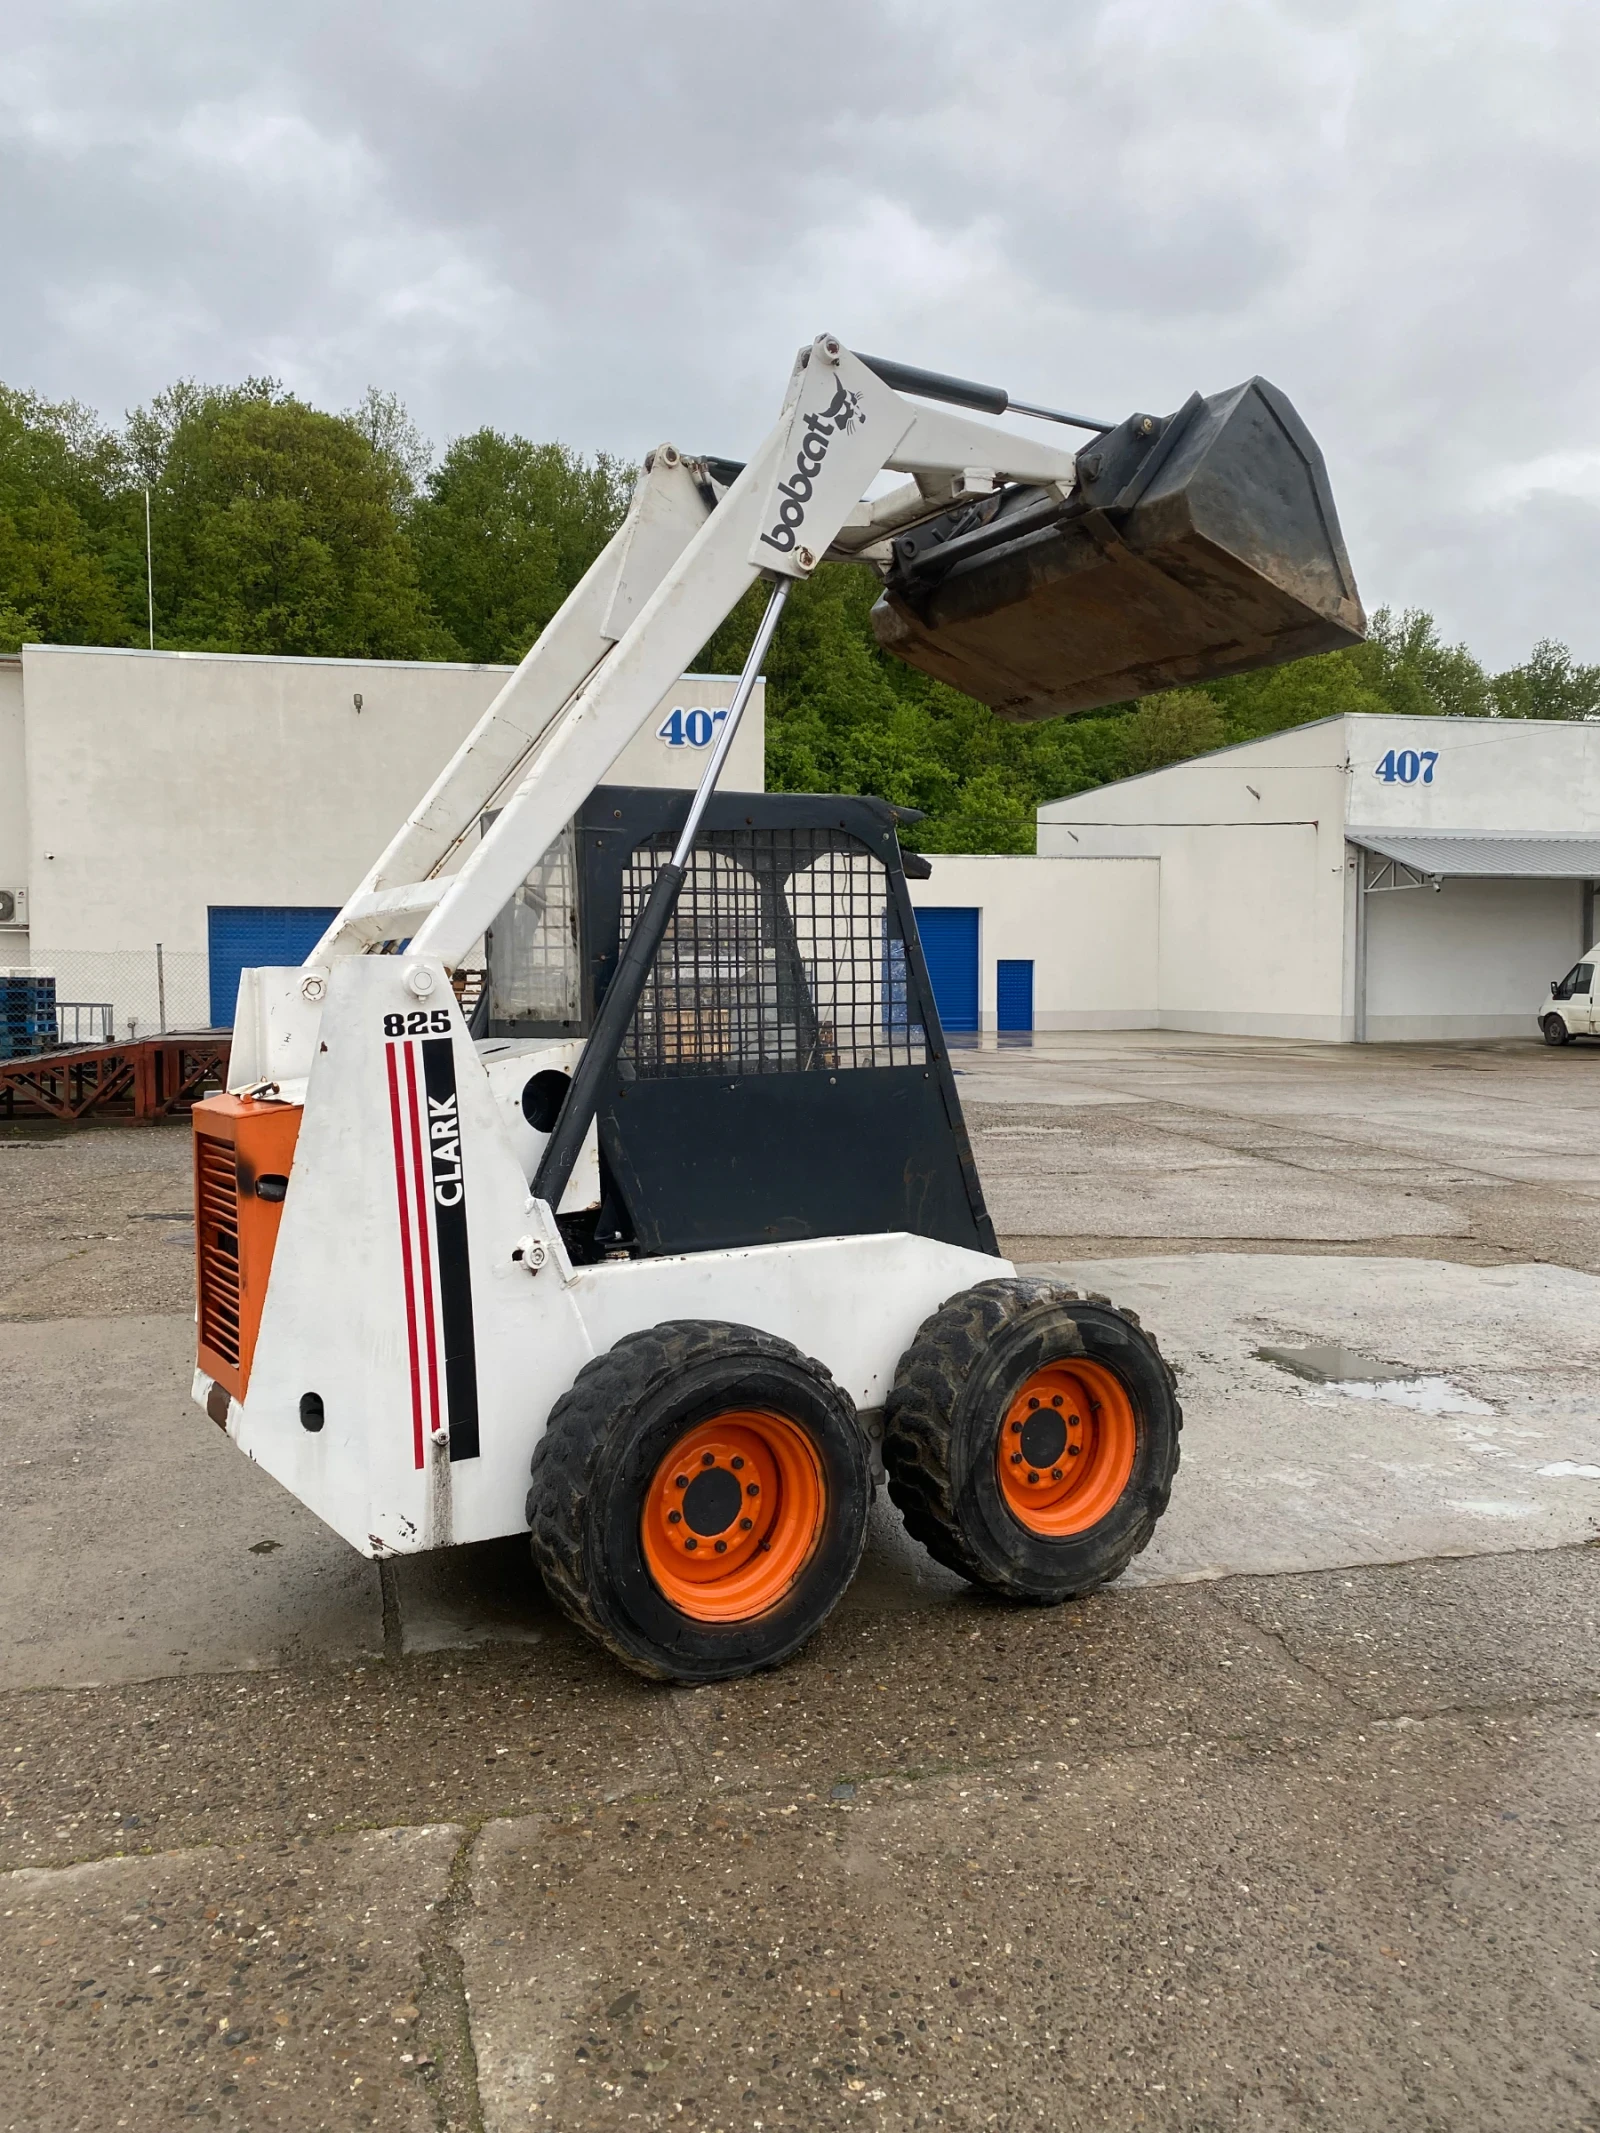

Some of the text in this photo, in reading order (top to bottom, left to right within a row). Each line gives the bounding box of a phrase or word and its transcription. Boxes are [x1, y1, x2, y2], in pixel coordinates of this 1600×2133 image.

[760, 412, 835, 553] bobcat
[1374, 749, 1439, 784] 407
[383, 1009, 452, 1037] 825
[427, 1092, 464, 1207] CLARK
